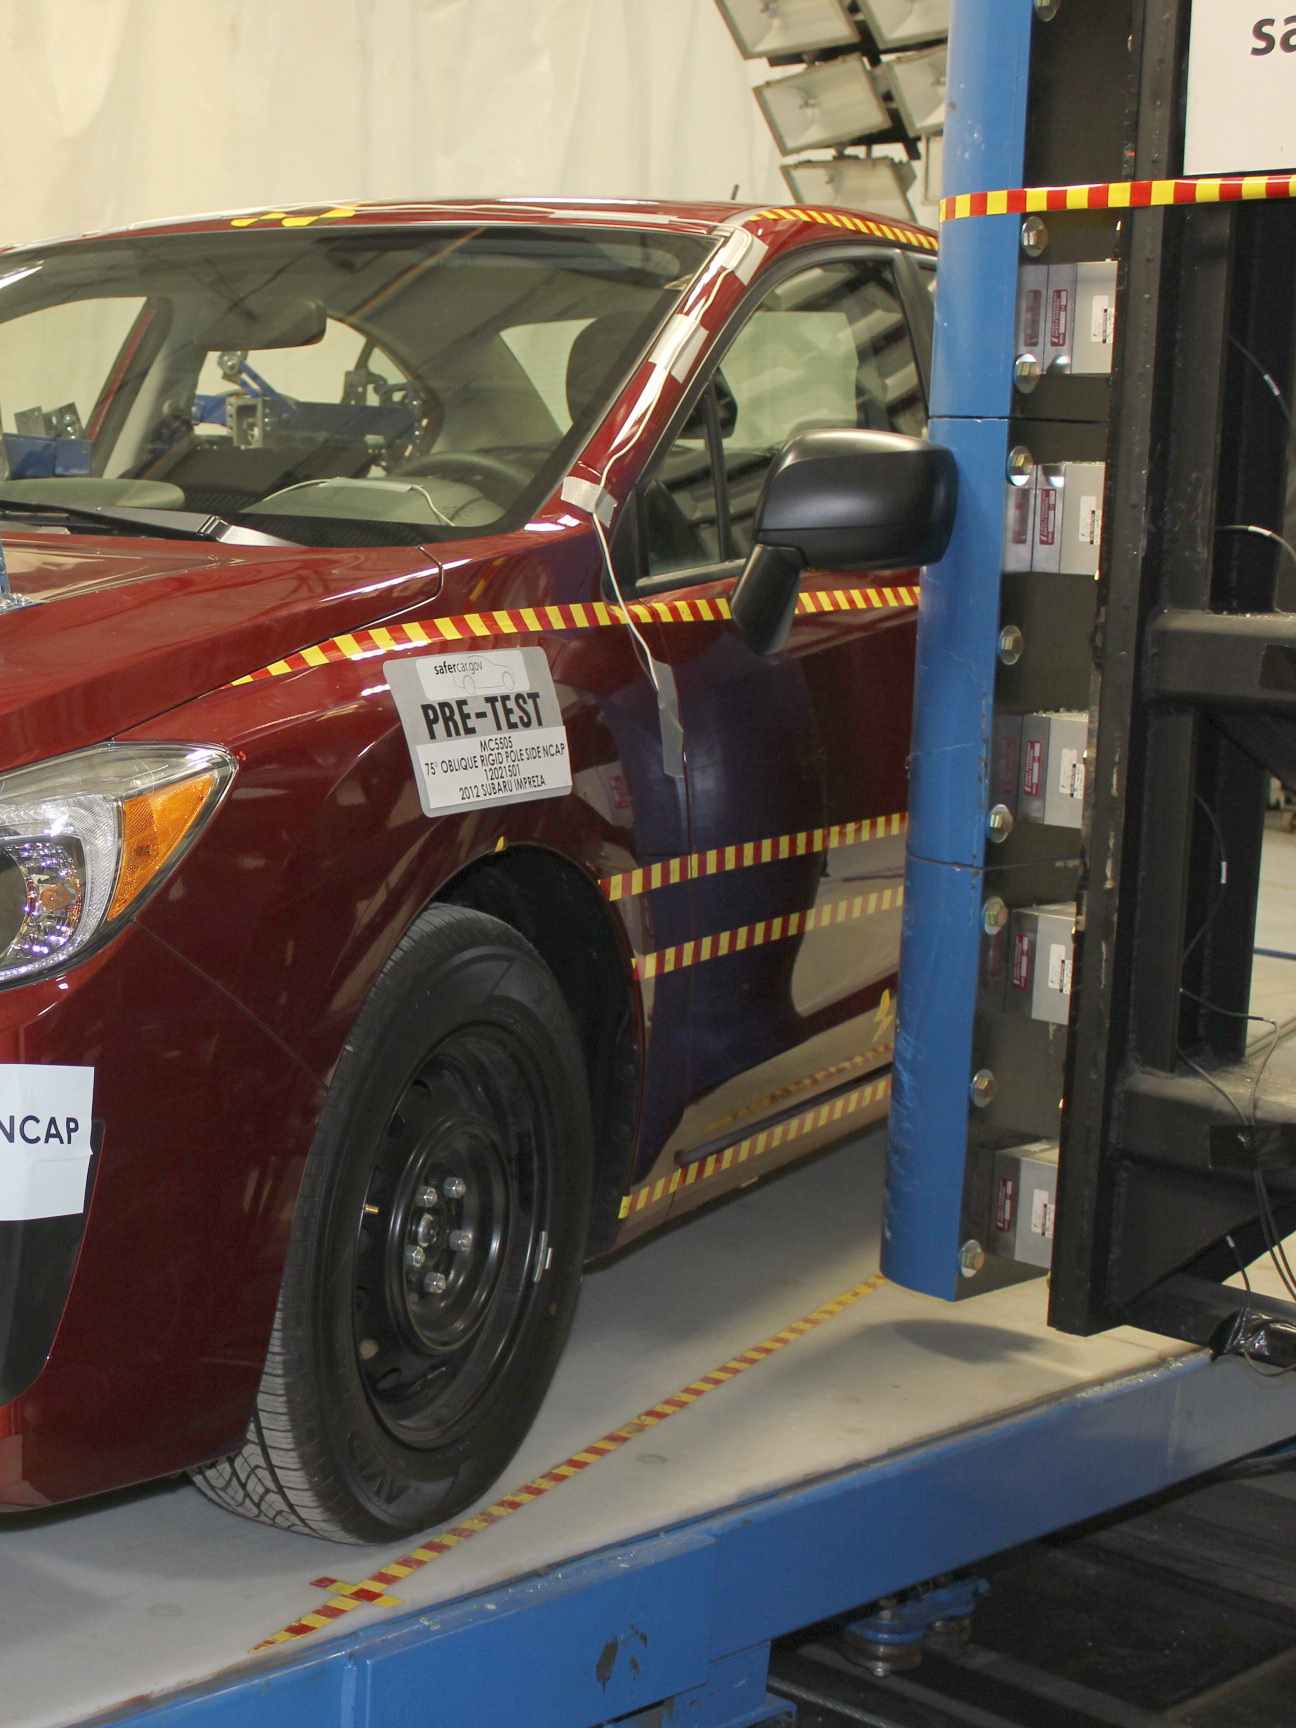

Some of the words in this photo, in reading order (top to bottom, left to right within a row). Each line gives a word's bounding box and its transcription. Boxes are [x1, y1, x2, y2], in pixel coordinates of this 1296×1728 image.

[433, 660, 483, 675] safercar.gov
[420, 691, 543, 740] PRE-TEST
[480, 736, 513, 753] MC5505
[440, 755, 479, 773] OBLIQUE
[479, 752, 504, 768] RIGID
[505, 749, 525, 764] POLE
[525, 746, 542, 760] SIDE
[543, 742, 566, 758] NCAP
[484, 763, 521, 781] 12021501
[459, 785, 480, 800] 2012
[481, 779, 513, 797] SUBARU
[514, 774, 546, 791] IMPREZA
